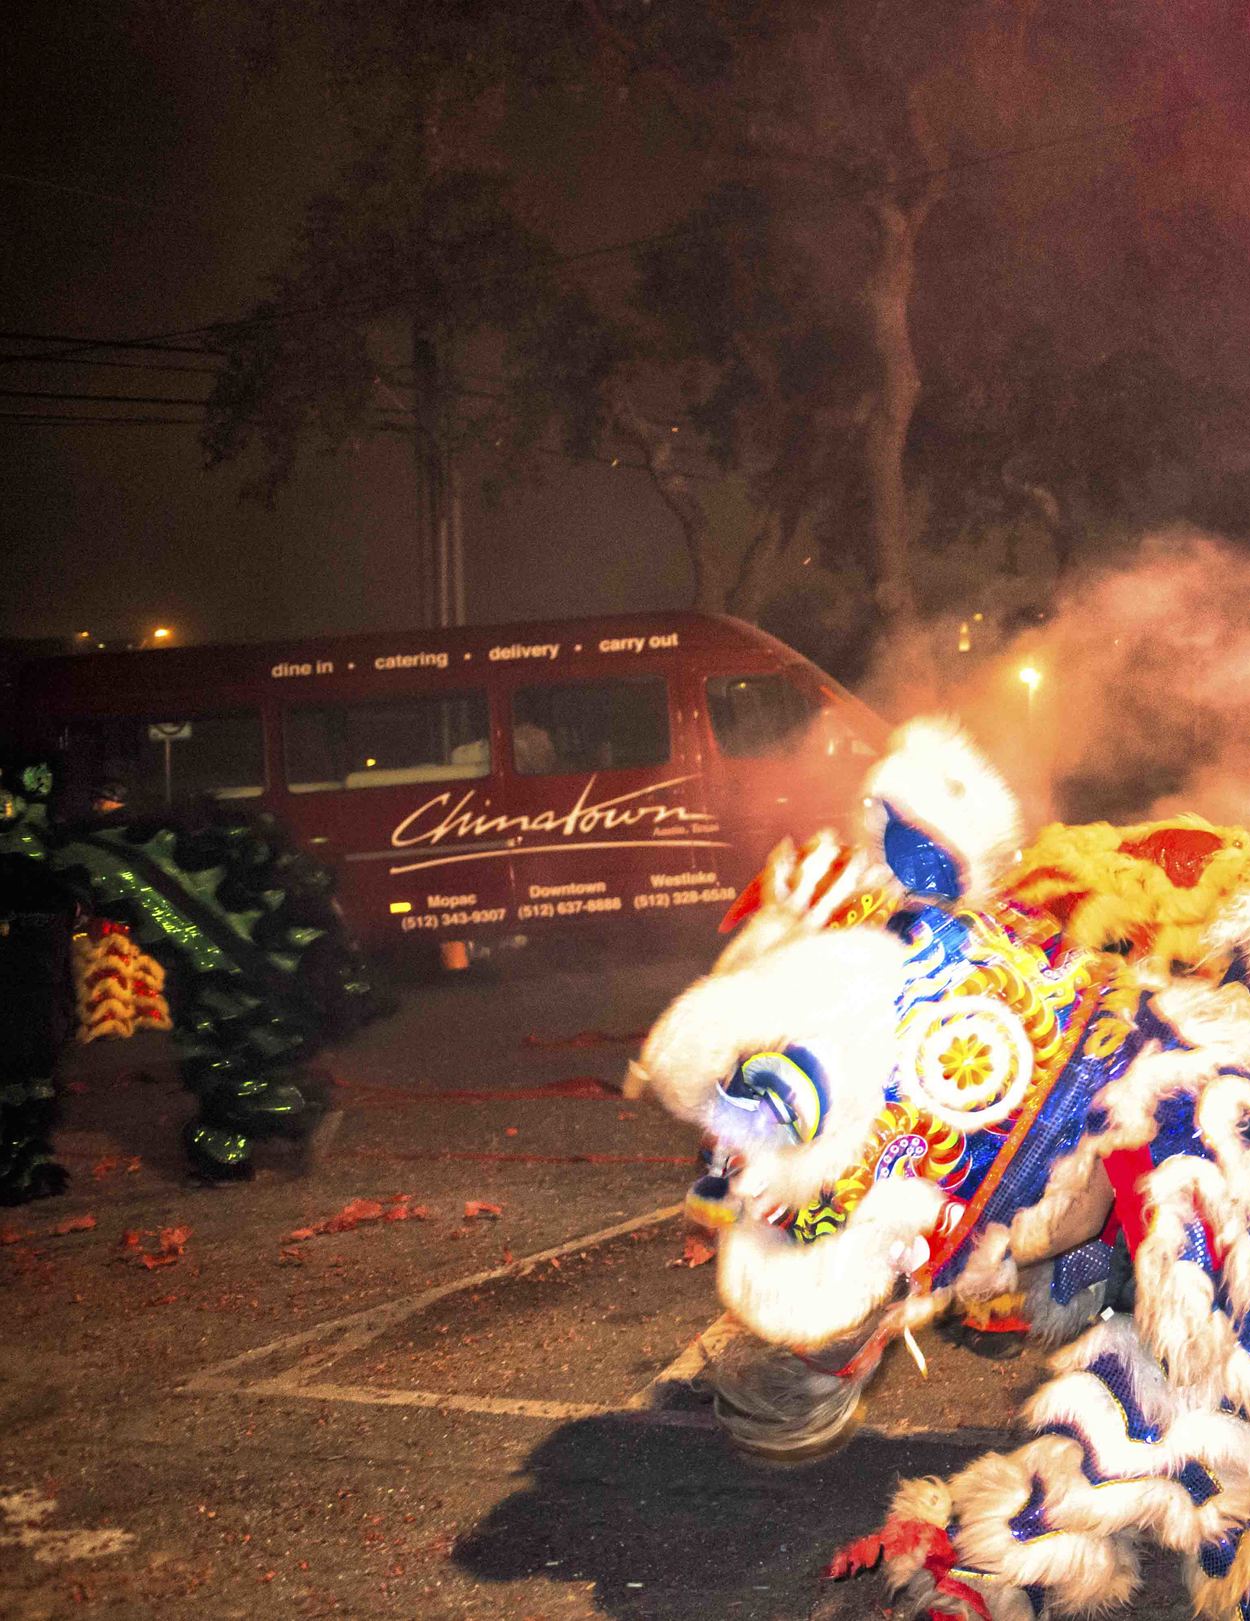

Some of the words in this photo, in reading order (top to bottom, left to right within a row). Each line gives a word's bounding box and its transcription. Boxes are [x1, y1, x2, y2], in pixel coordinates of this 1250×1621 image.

[271, 661, 312, 678] dine
[316, 659, 334, 674] in
[374, 652, 449, 670] catering
[488, 643, 560, 661] delivery
[599, 637, 646, 653] carry
[648, 632, 679, 648] out
[390, 774, 717, 848] Chinatown
[650, 871, 717, 888] Westlake
[528, 881, 607, 899] Downtown
[427, 894, 477, 909] Mopac
[633, 892, 671, 910] (512)
[518, 903, 555, 920] (512)
[401, 915, 439, 932] (512)
